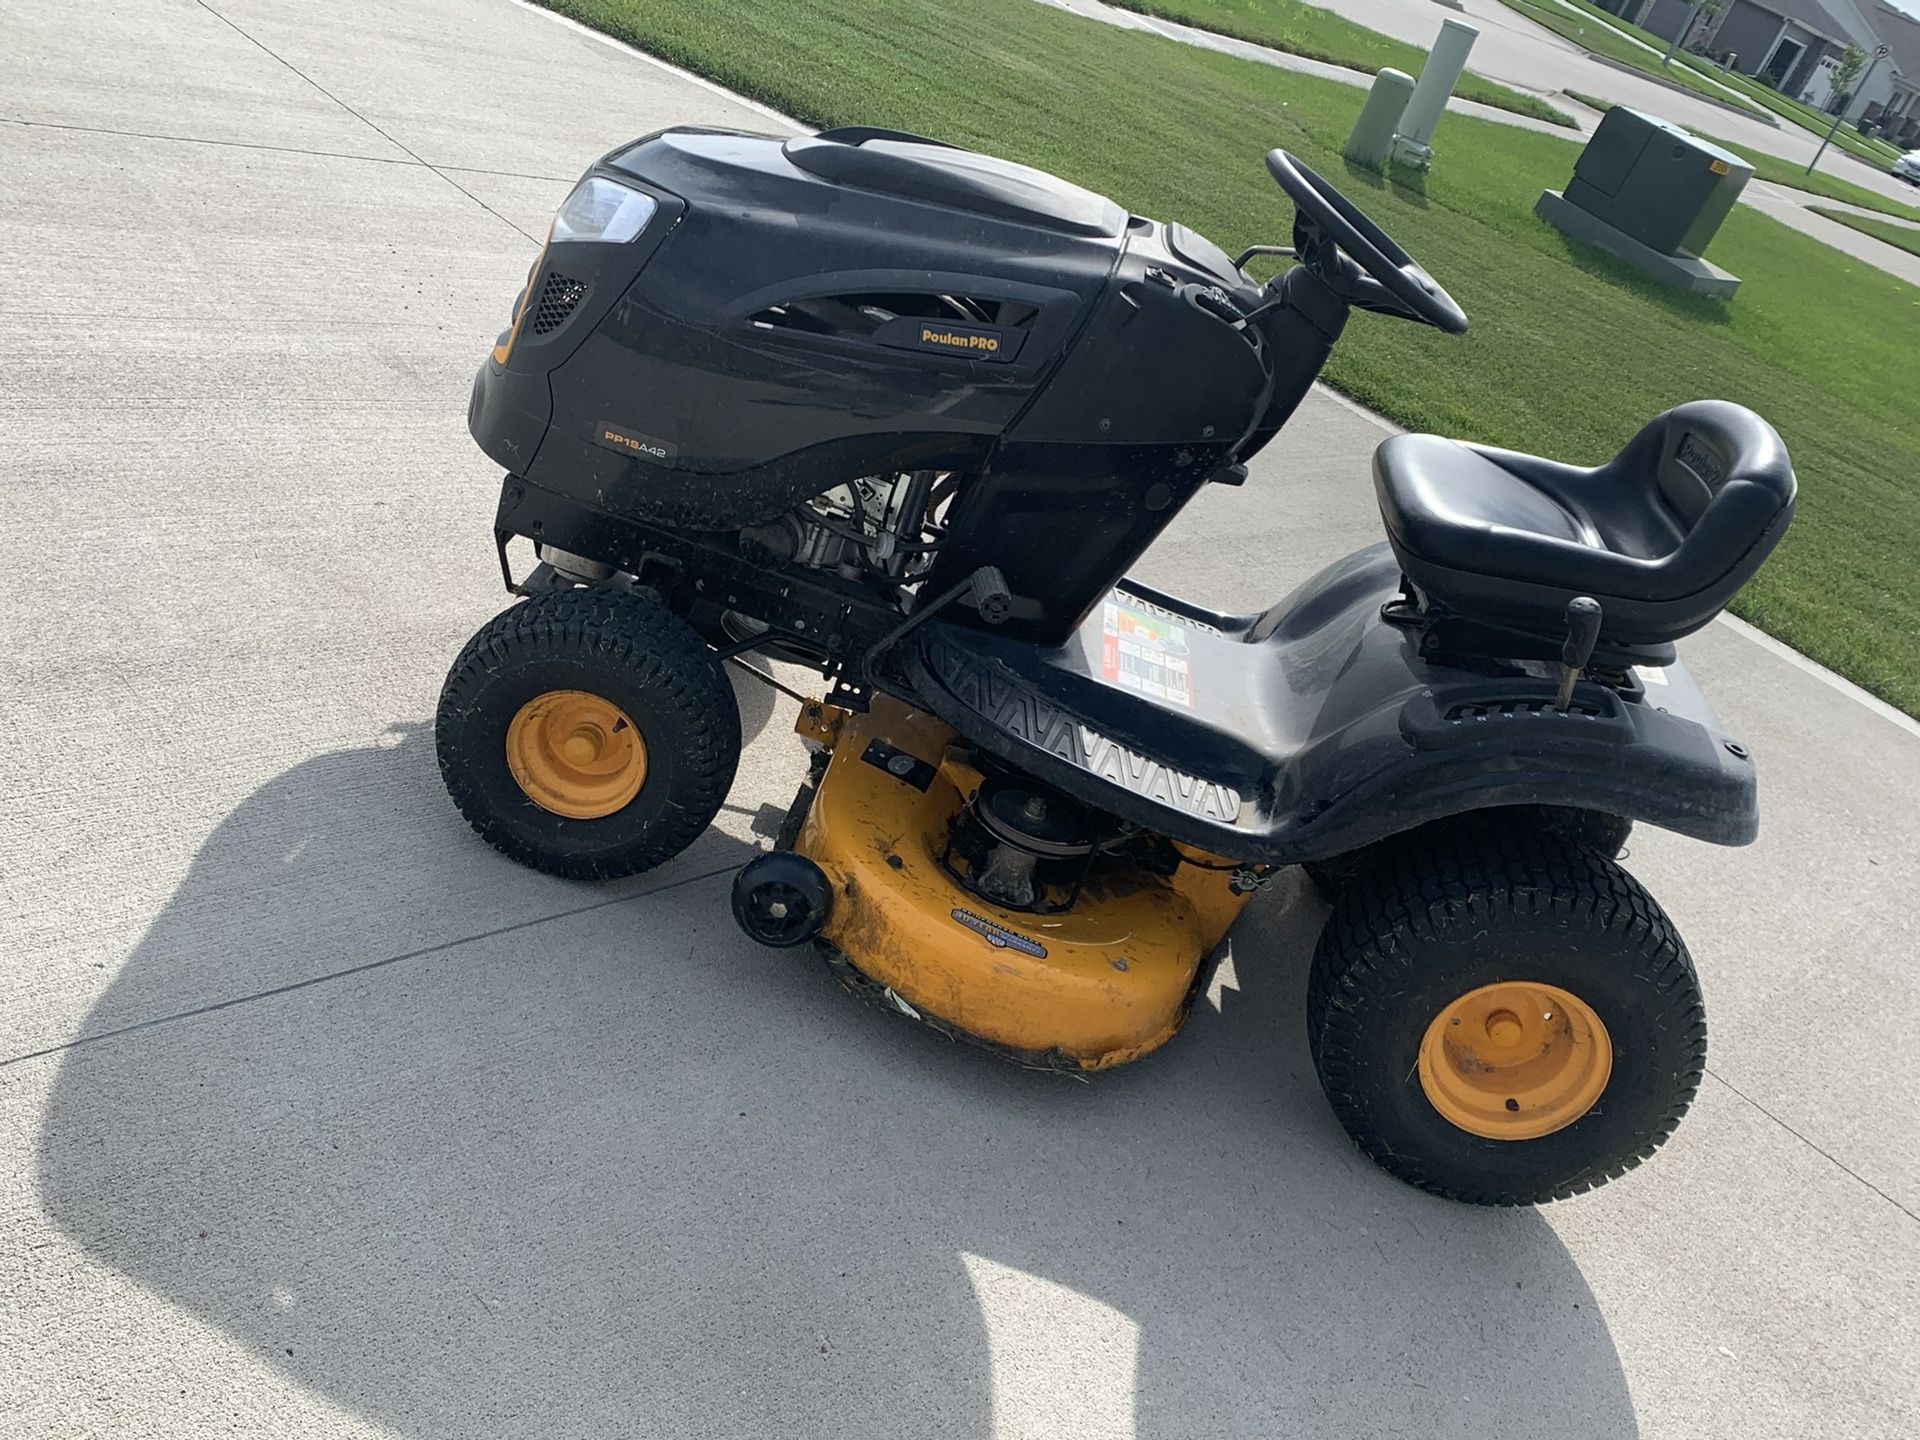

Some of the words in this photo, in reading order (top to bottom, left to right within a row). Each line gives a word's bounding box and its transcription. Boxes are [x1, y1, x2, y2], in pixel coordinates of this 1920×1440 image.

[922, 329, 968, 347] Poulan
[969, 335, 998, 351] PRO
[604, 430, 666, 459] PP19A42
